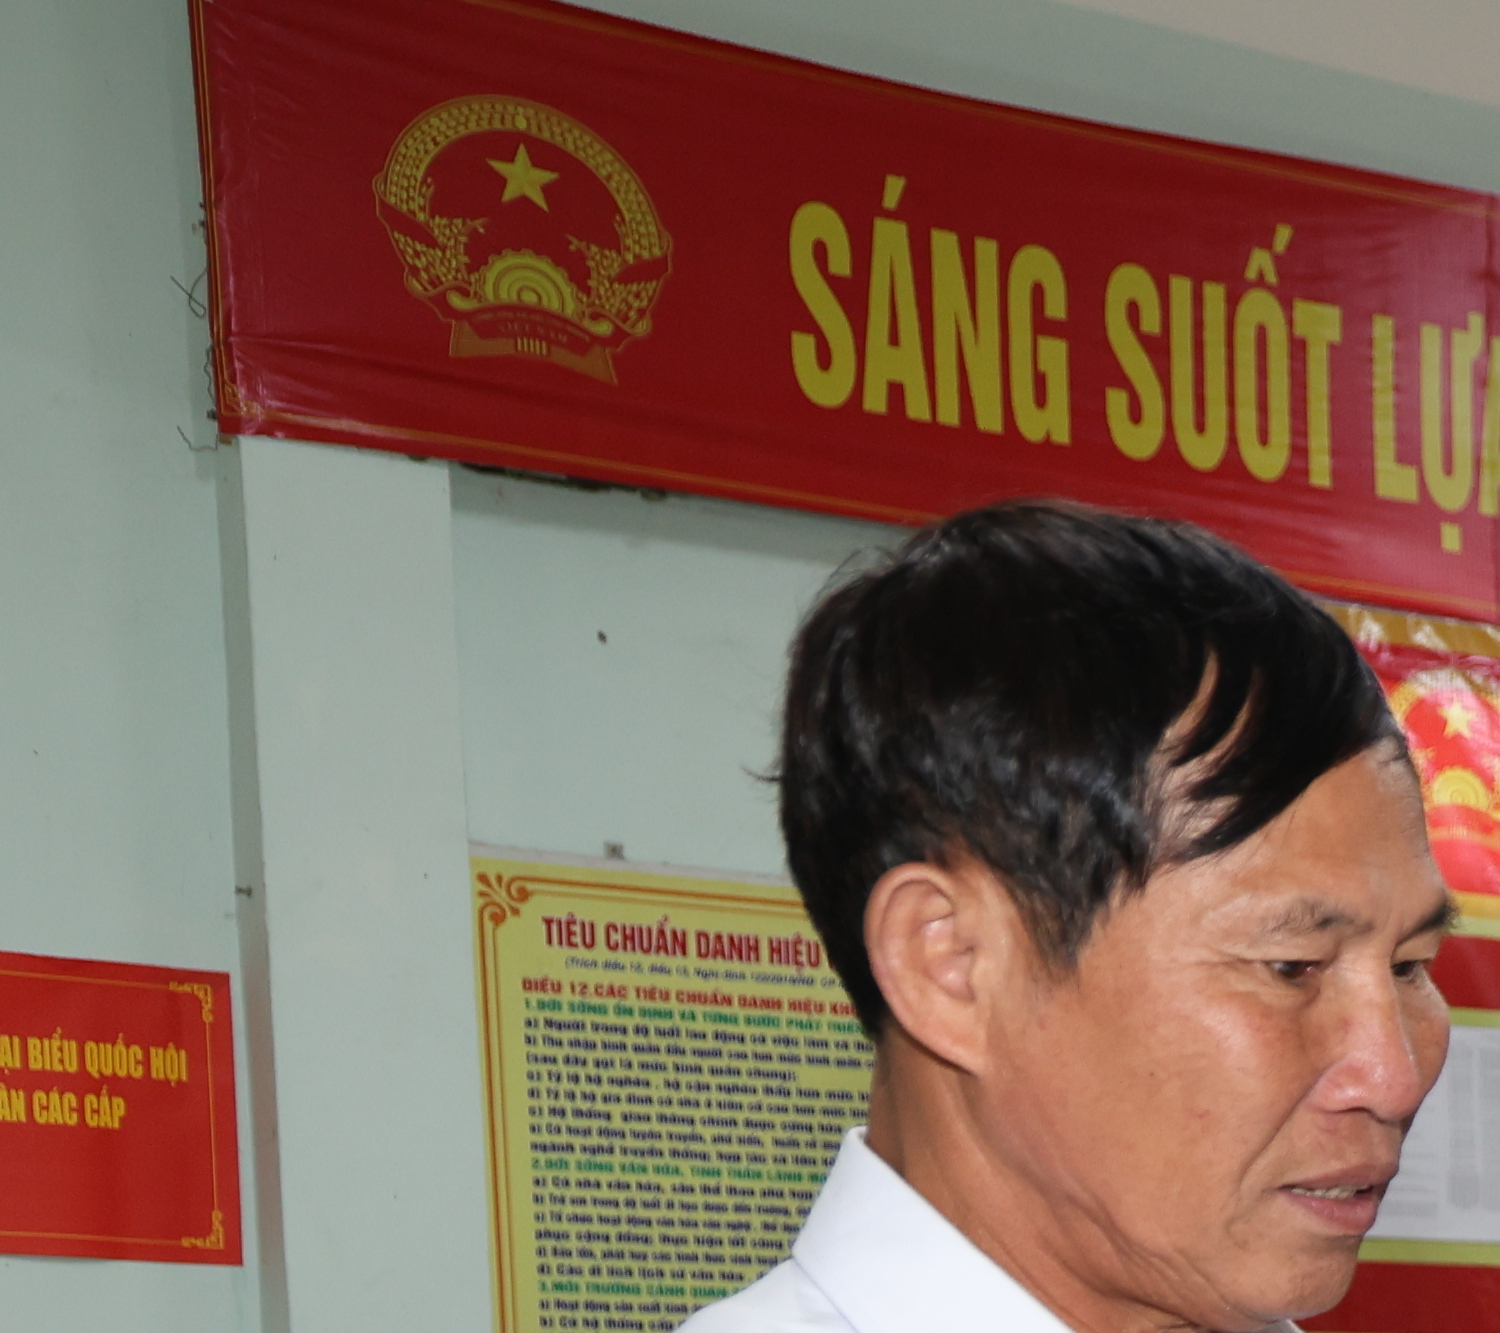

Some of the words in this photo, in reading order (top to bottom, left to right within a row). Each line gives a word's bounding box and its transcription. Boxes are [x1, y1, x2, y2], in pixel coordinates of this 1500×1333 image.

[791, 175, 1069, 443] SÁNG
[1105, 225, 1340, 487] SUỐT
[542, 912, 595, 949] TIÊU
[604, 914, 687, 957] CHUẨN
[695, 930, 759, 963] DANH
[768, 932, 820, 973] HIỆU
[27, 1027, 78, 1074] BIỂU
[84, 1032, 144, 1079] QUỐC
[149, 1042, 188, 1087] HỘI
[32, 1086, 78, 1125] CÁC
[84, 1084, 126, 1130] CẤP
